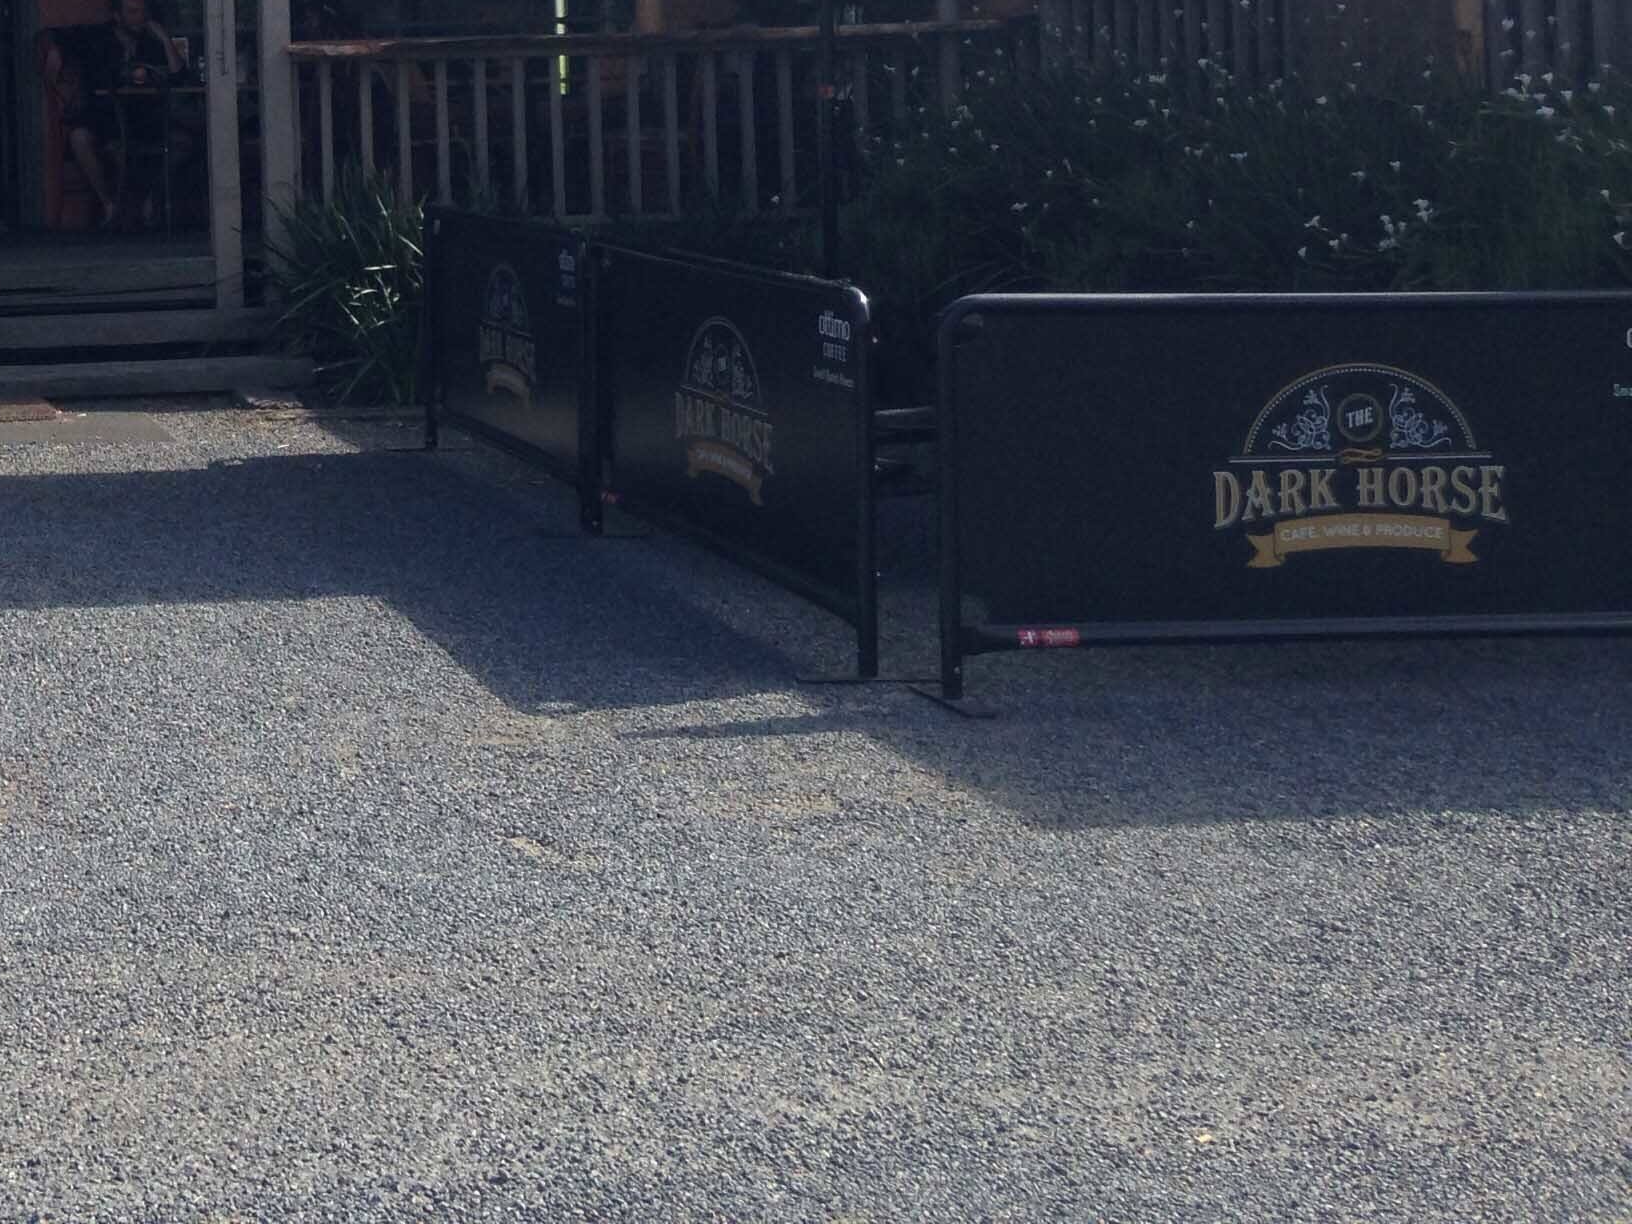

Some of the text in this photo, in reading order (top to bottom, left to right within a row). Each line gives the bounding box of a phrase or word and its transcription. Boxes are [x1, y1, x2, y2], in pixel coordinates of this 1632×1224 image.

[1346, 406, 1374, 429] THE
[1213, 465, 1510, 528] DARK HORSE
[1323, 525, 1361, 538] WINE
[1375, 524, 1445, 539] PRODUCE
